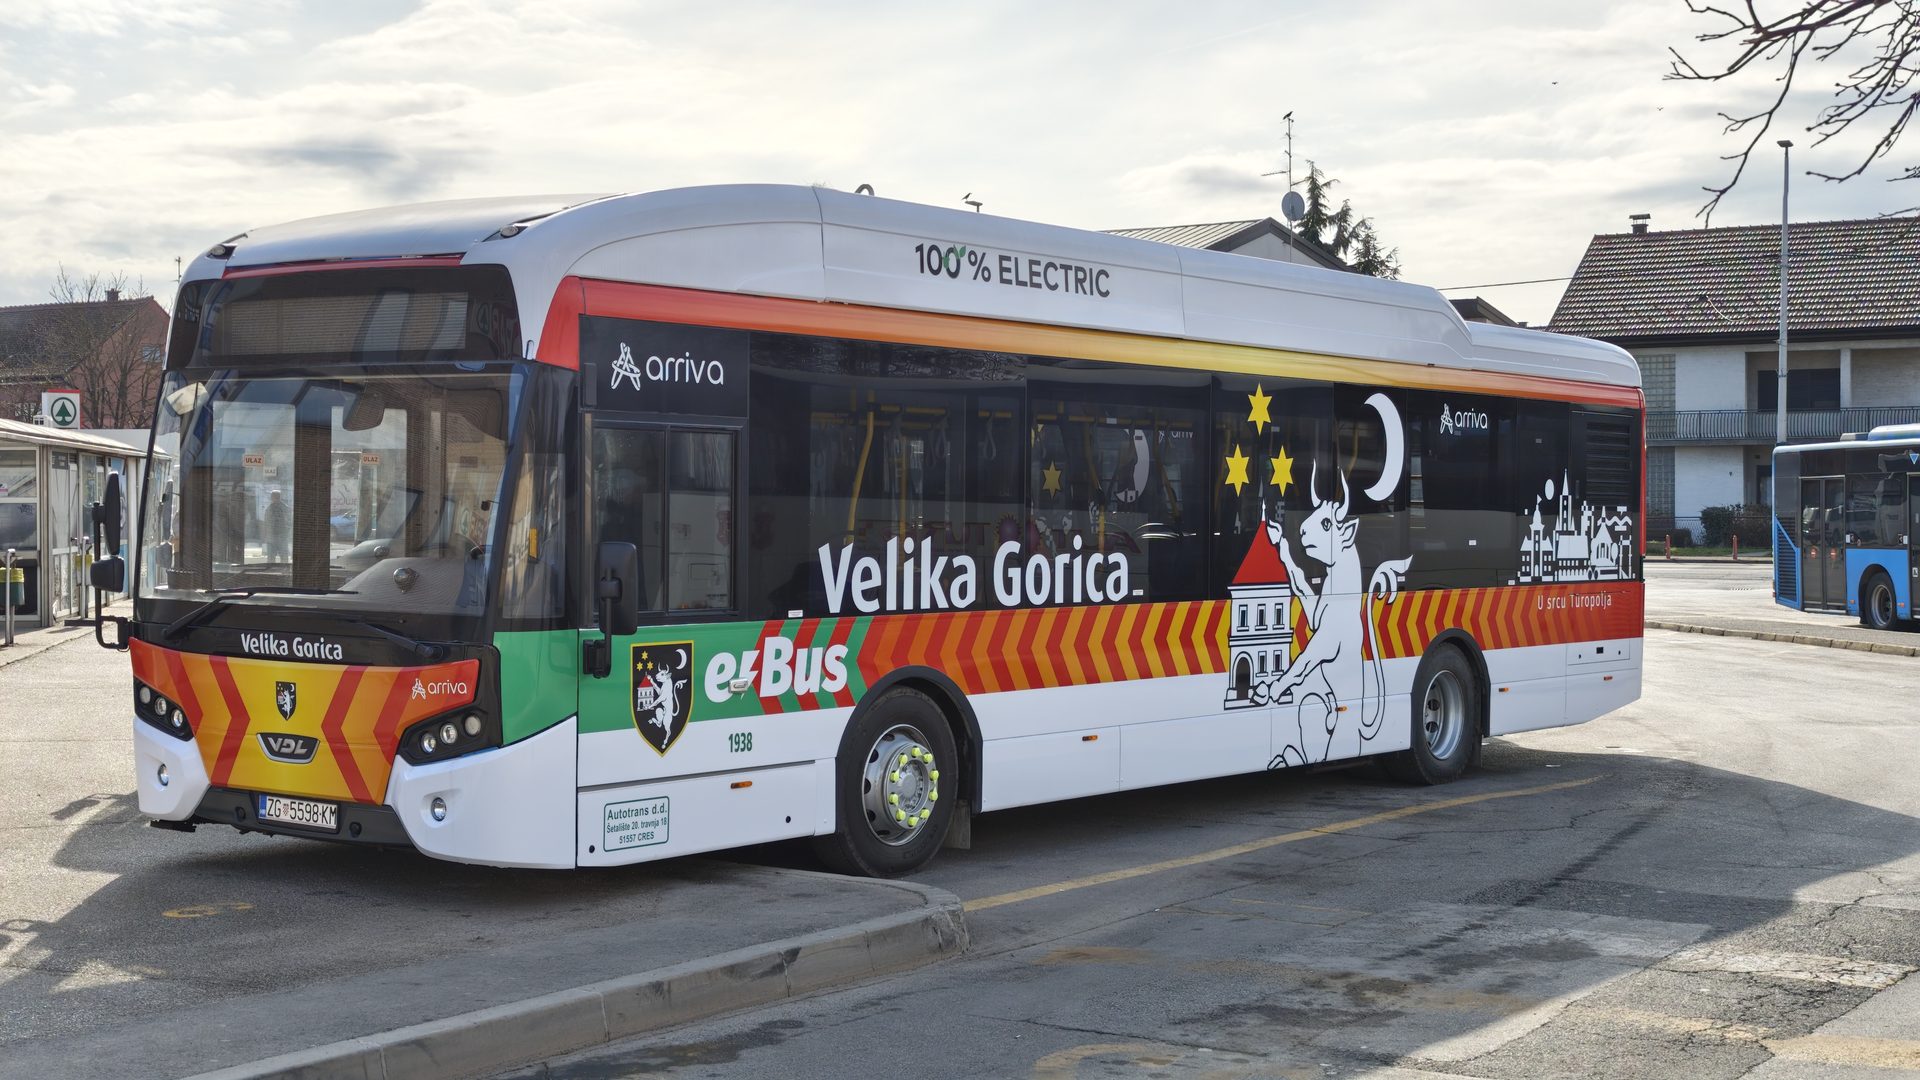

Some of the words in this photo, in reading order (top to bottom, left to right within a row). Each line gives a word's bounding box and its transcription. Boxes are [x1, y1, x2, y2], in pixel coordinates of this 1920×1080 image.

[998, 254, 1110, 298] ELECTRIC
[646, 351, 724, 385] arriva
[1454, 407, 1488, 429] arriva
[818, 535, 976, 613] Velika
[993, 534, 1128, 607] Gorica
[1537, 595, 1543, 610] U
[1546, 595, 1566, 609] srcu
[240, 633, 288, 656] Velika
[292, 637, 342, 660] Gorica
[427, 680, 467, 695] arriva
[267, 736, 308, 755] VDL
[728, 732, 752, 752] 1938
[267, 798, 281, 818] ZG
[607, 807, 649, 820] Autotrans
[652, 803, 667, 814] d.d.
[606, 822, 630, 833] Šetalište
[631, 821, 640, 830] 20.
[640, 818, 659, 829] travnja
[660, 817, 667, 825] 18
[619, 834, 636, 844] 51557
[637, 831, 654, 841] CRES
